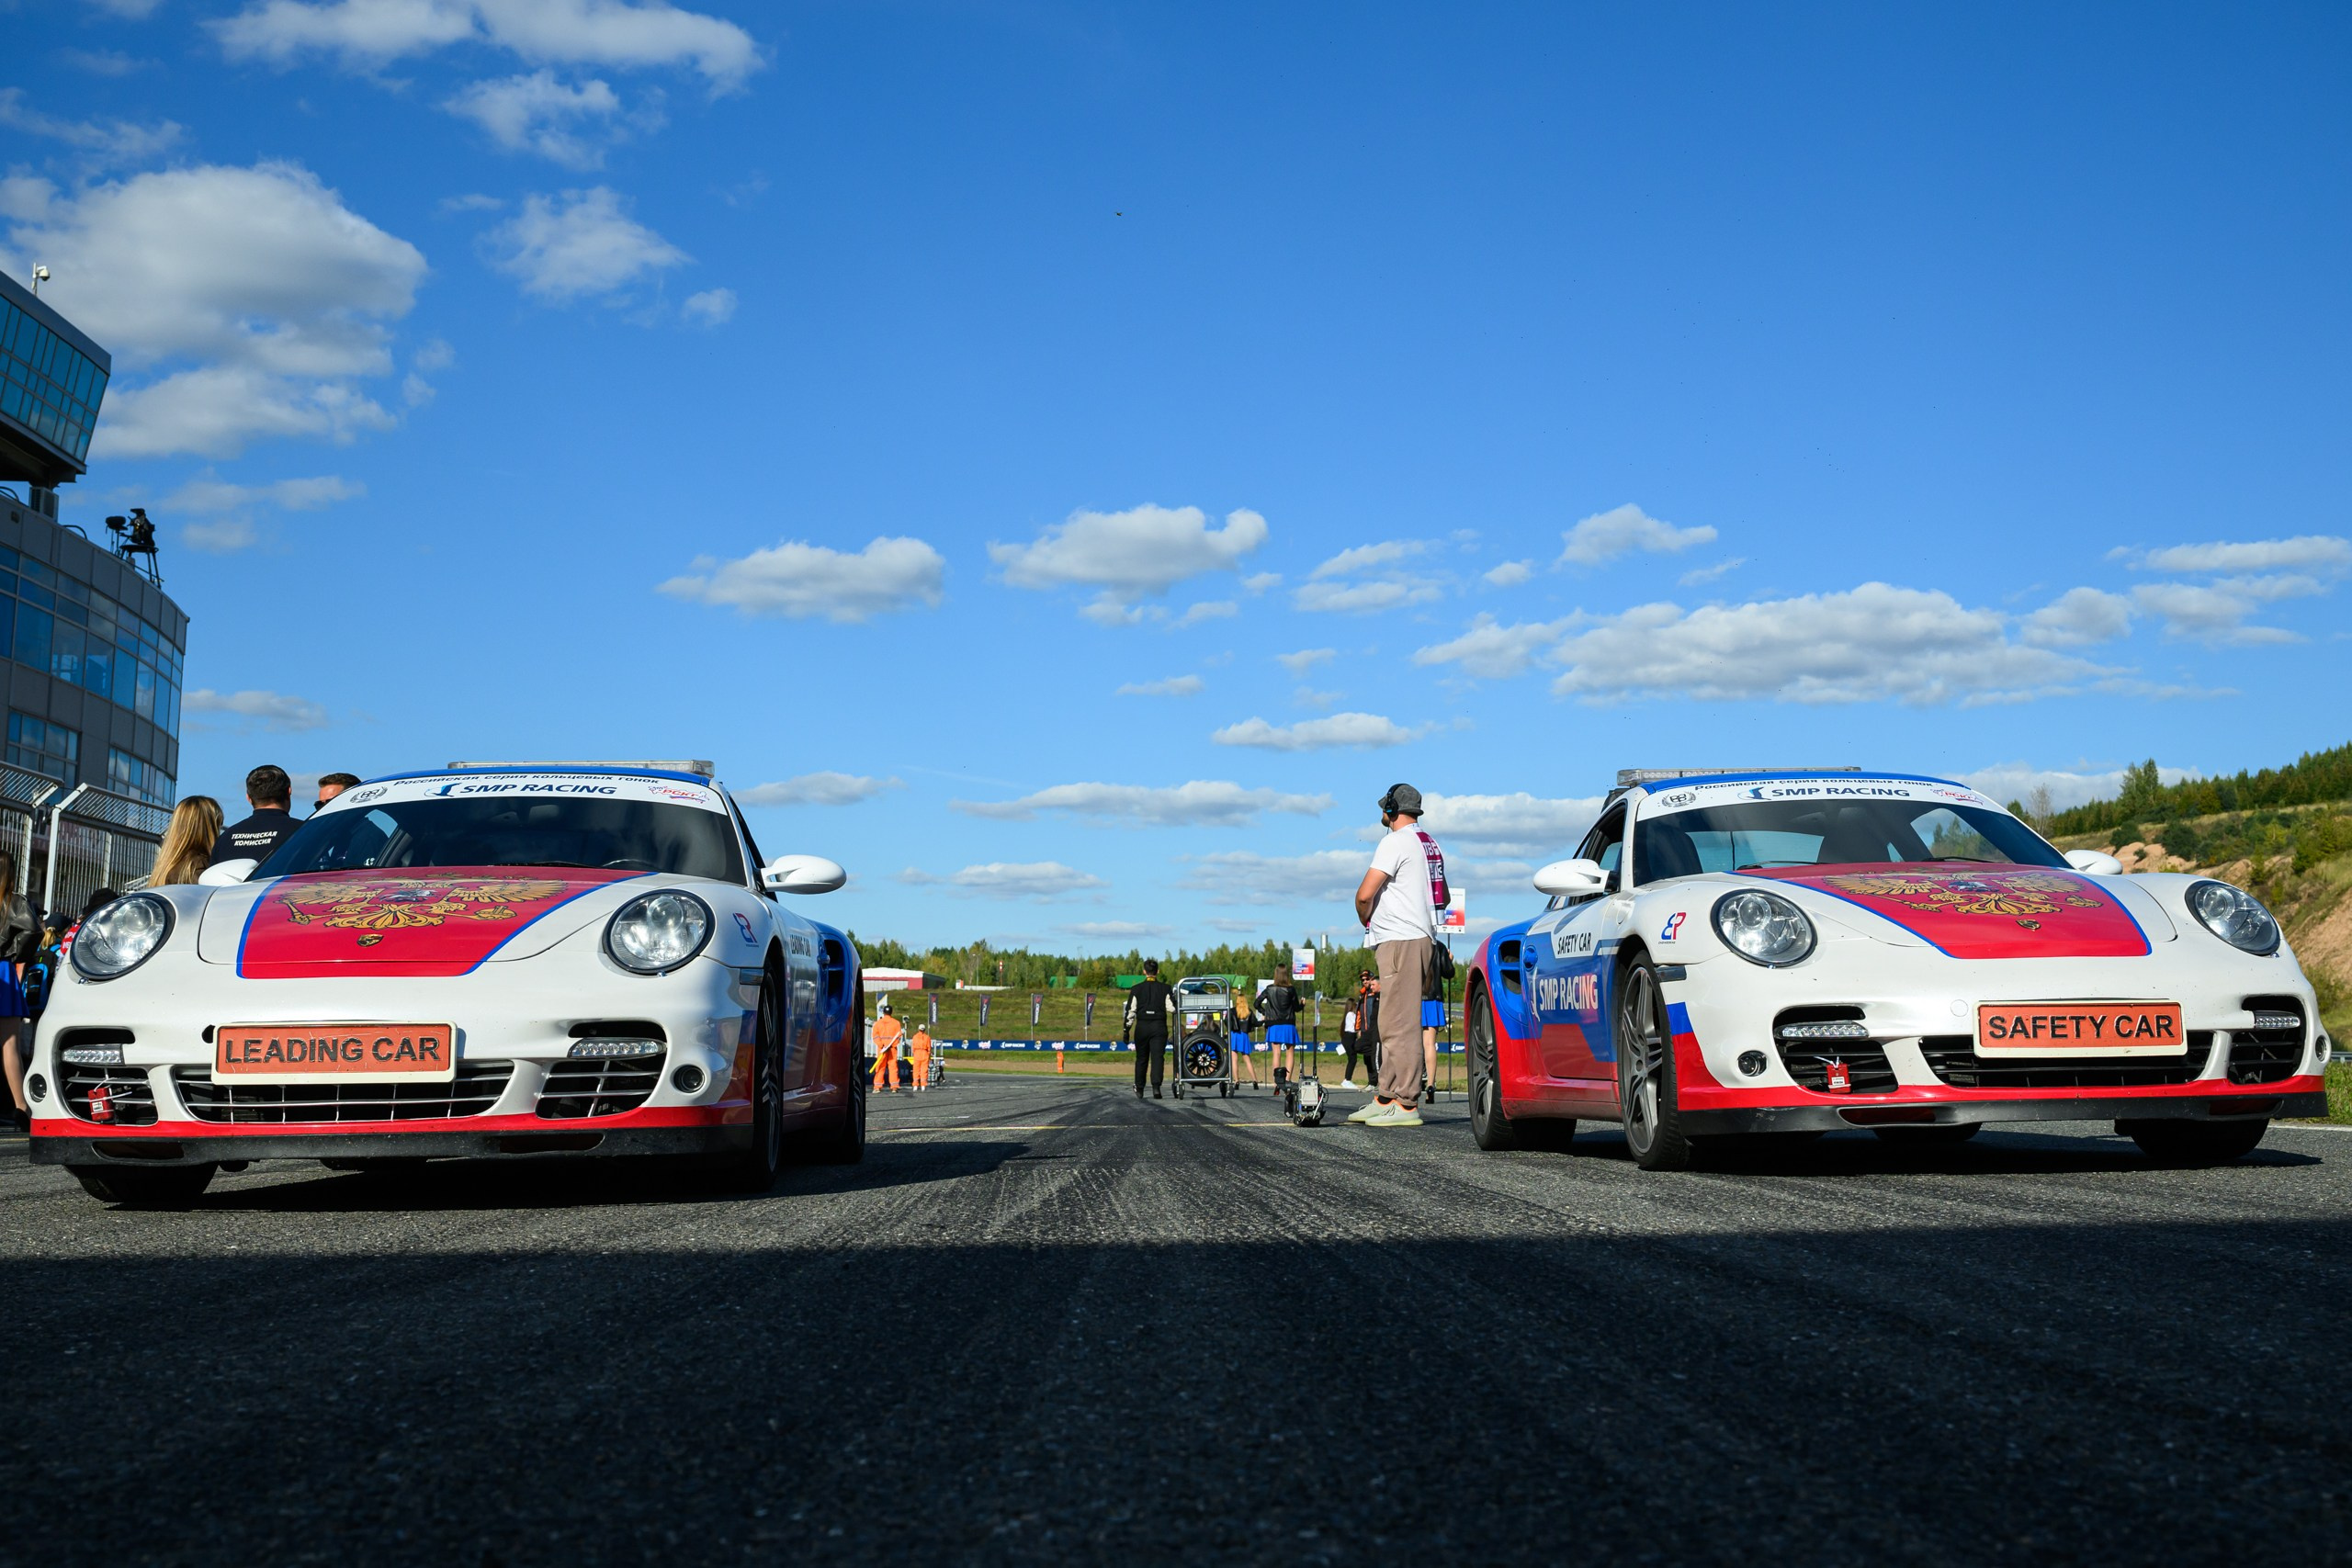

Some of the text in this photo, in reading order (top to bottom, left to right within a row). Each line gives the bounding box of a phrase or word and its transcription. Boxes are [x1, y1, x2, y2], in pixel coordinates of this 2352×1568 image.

[393, 775, 480, 786] Российская
[1694, 780, 1774, 790] Российская
[459, 784, 617, 795] SMP RACING
[1771, 787, 1910, 797] SMP RACING
[232, 830, 277, 840] ТЕХНИЧЕСКАЯ
[233, 838, 272, 846] КОМИССИЯ
[1557, 932, 1591, 954] SAFETY CAR
[1539, 974, 1599, 1010] SMP RACING
[1987, 1014, 2176, 1040] SAFETY CAR
[225, 1036, 441, 1064] LEADING CAR
